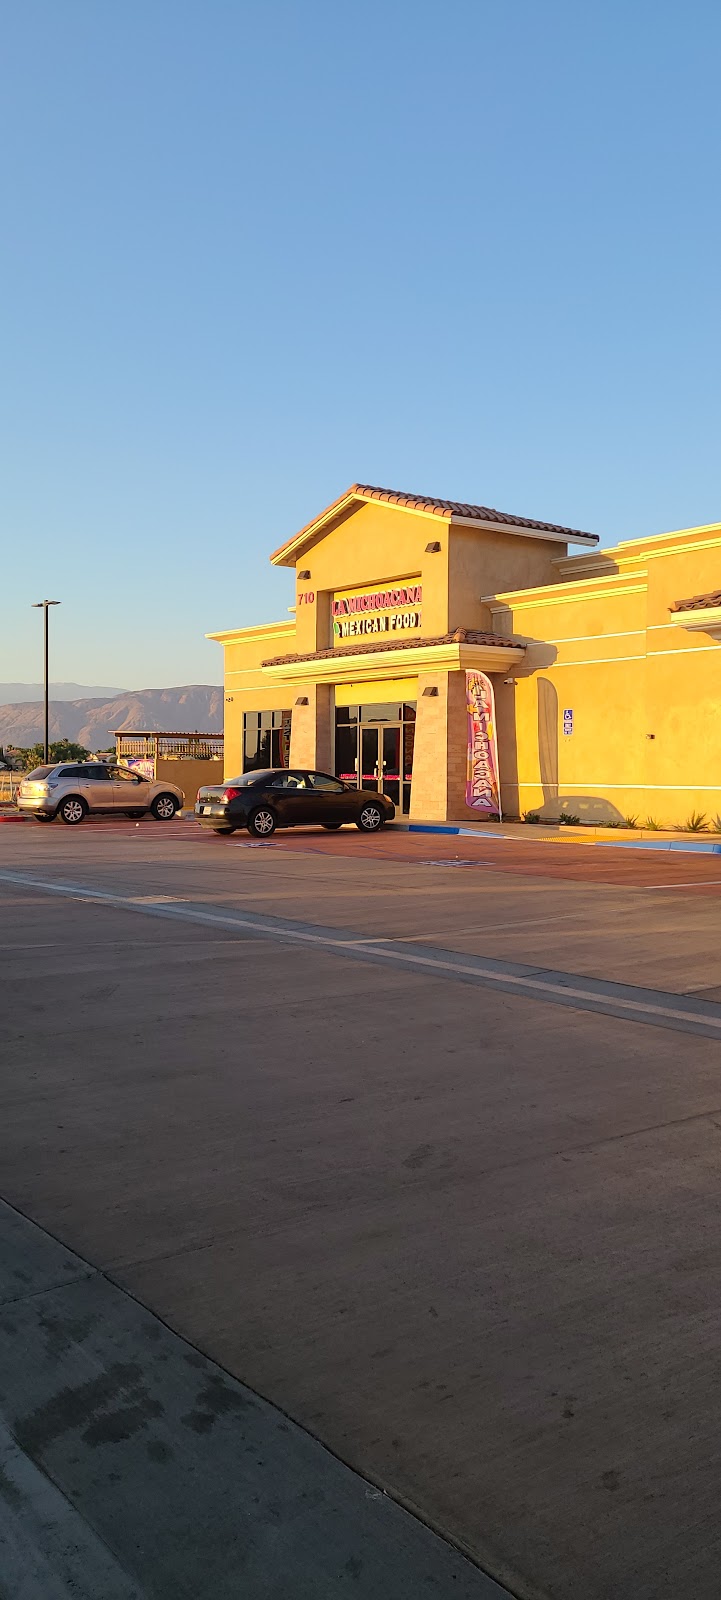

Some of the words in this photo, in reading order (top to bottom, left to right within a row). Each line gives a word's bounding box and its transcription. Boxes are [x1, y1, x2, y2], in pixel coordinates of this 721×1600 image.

[297, 591, 315, 605] 710
[331, 600, 347, 616] LA
[348, 586, 422, 614] MICHOACANA
[342, 617, 386, 637] MEXICAN
[390, 612, 417, 630] FOOD
